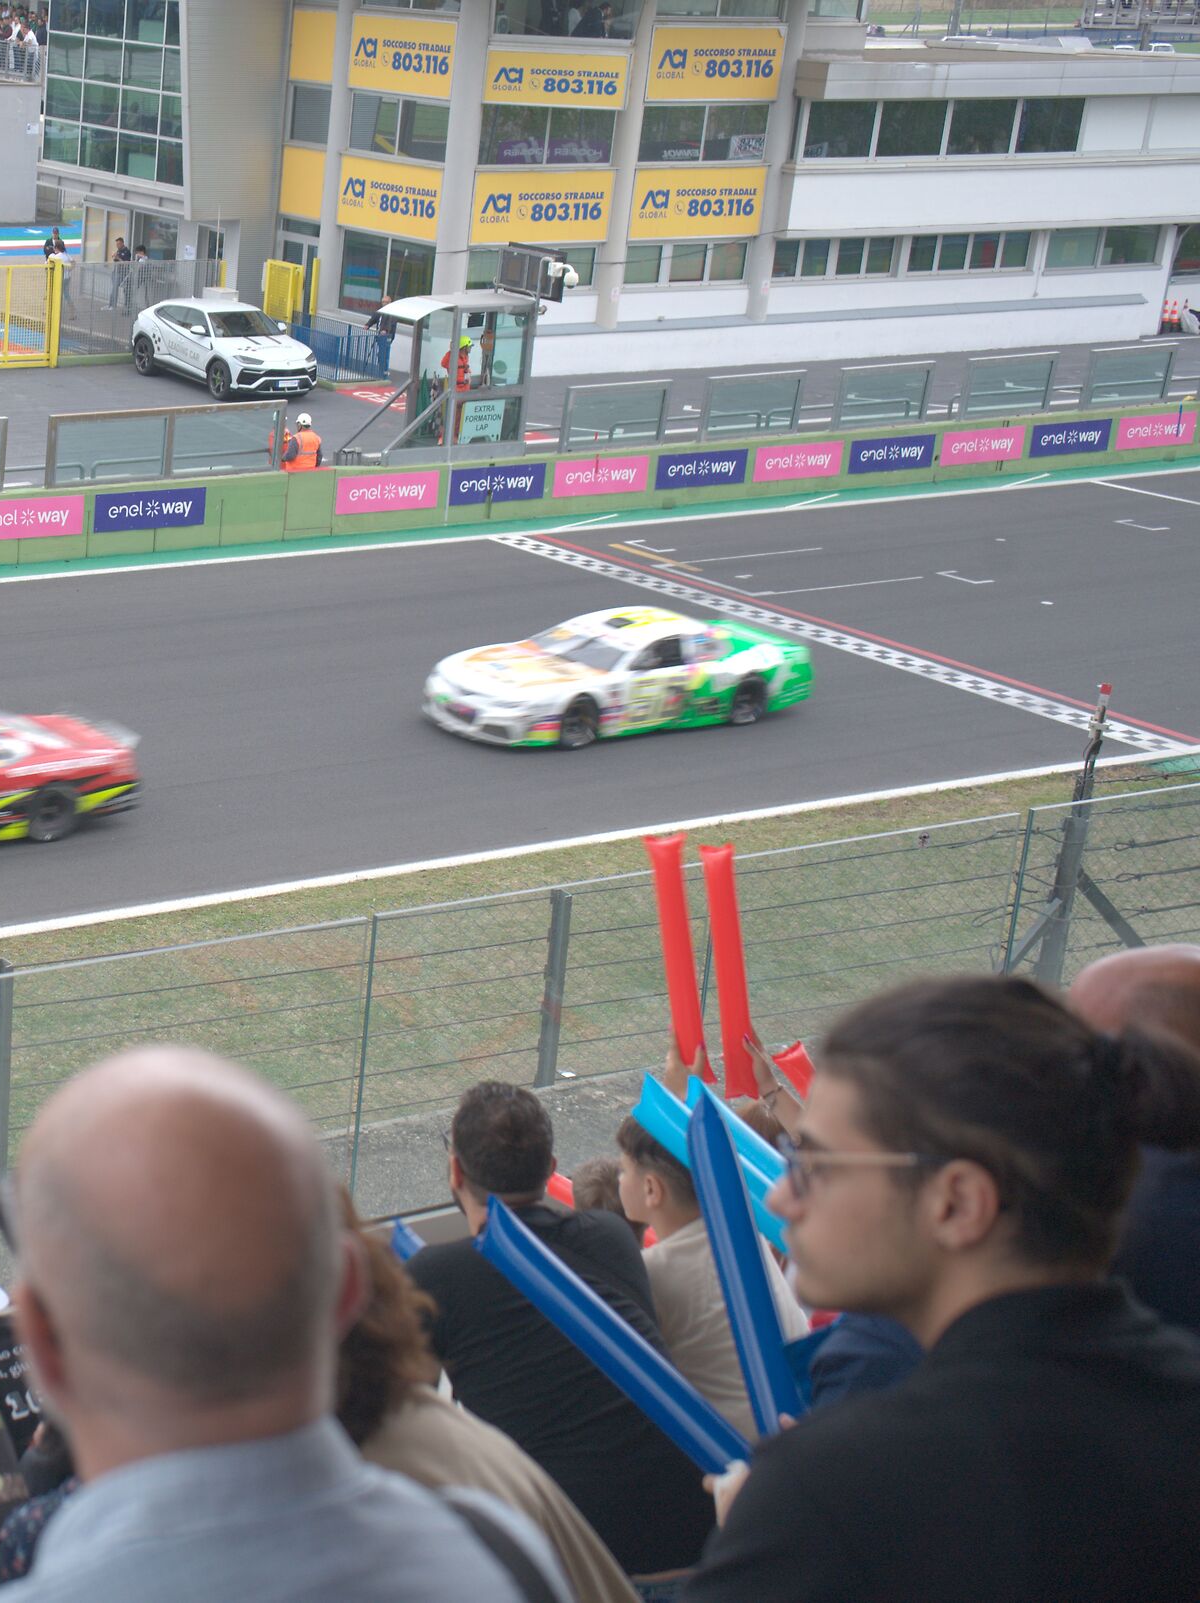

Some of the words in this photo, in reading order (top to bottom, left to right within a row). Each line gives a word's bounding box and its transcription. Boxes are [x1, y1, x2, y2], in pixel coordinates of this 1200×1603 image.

[355, 37, 377, 58] ACI
[382, 39, 416, 50] SOCCORSO
[418, 42, 450, 53] STRADALE
[694, 49, 735, 57] SOCCORSO
[737, 49, 776, 57] STRADALE
[353, 59, 376, 68] GLOBAL
[392, 51, 449, 75] 803.116
[658, 49, 687, 69] ACI
[494, 67, 523, 83] ACI
[530, 68, 574, 77] SOCCORSO
[577, 69, 619, 79] STRADALE
[705, 59, 773, 78] 803.116
[543, 78, 617, 95] 803.116
[343, 176, 365, 199] ACI
[370, 180, 403, 193] SOCCORSO
[405, 186, 437, 198] STRADALE
[518, 192, 562, 200] SOCCORSO
[564, 191, 604, 199] STRADALE
[676, 188, 717, 196] SOCCORSO
[719, 188, 757, 196] STRADALE
[341, 198, 364, 208] GLOBAL
[379, 194, 435, 219] 803.116
[481, 193, 512, 214] ACI
[640, 189, 670, 209] ACI
[530, 203, 601, 222] 803.116
[639, 211, 667, 219] GLOBAL
[687, 199, 754, 217] 803.116
[480, 215, 510, 223] GLOBAL
[474, 405, 495, 413] EXTRA
[464, 414, 502, 422] FORMATION
[1041, 431, 1066, 445] enel
[1078, 429, 1102, 445] way
[1127, 423, 1152, 438] enel
[1164, 423, 1186, 437] way
[860, 446, 887, 462] enel
[900, 445, 924, 461] way
[952, 439, 978, 454] enel
[991, 437, 1014, 452] way
[668, 460, 696, 477] enel
[711, 460, 737, 476] way
[765, 454, 793, 469] enel
[807, 453, 831, 468] way
[460, 476, 490, 492] enel
[506, 476, 534, 492] way
[566, 467, 595, 484] enel
[611, 468, 637, 484] way
[349, 486, 381, 501] enel
[398, 483, 426, 500] way
[108, 501, 143, 518] enel
[162, 500, 192, 517] way
[37, 509, 69, 527] way
